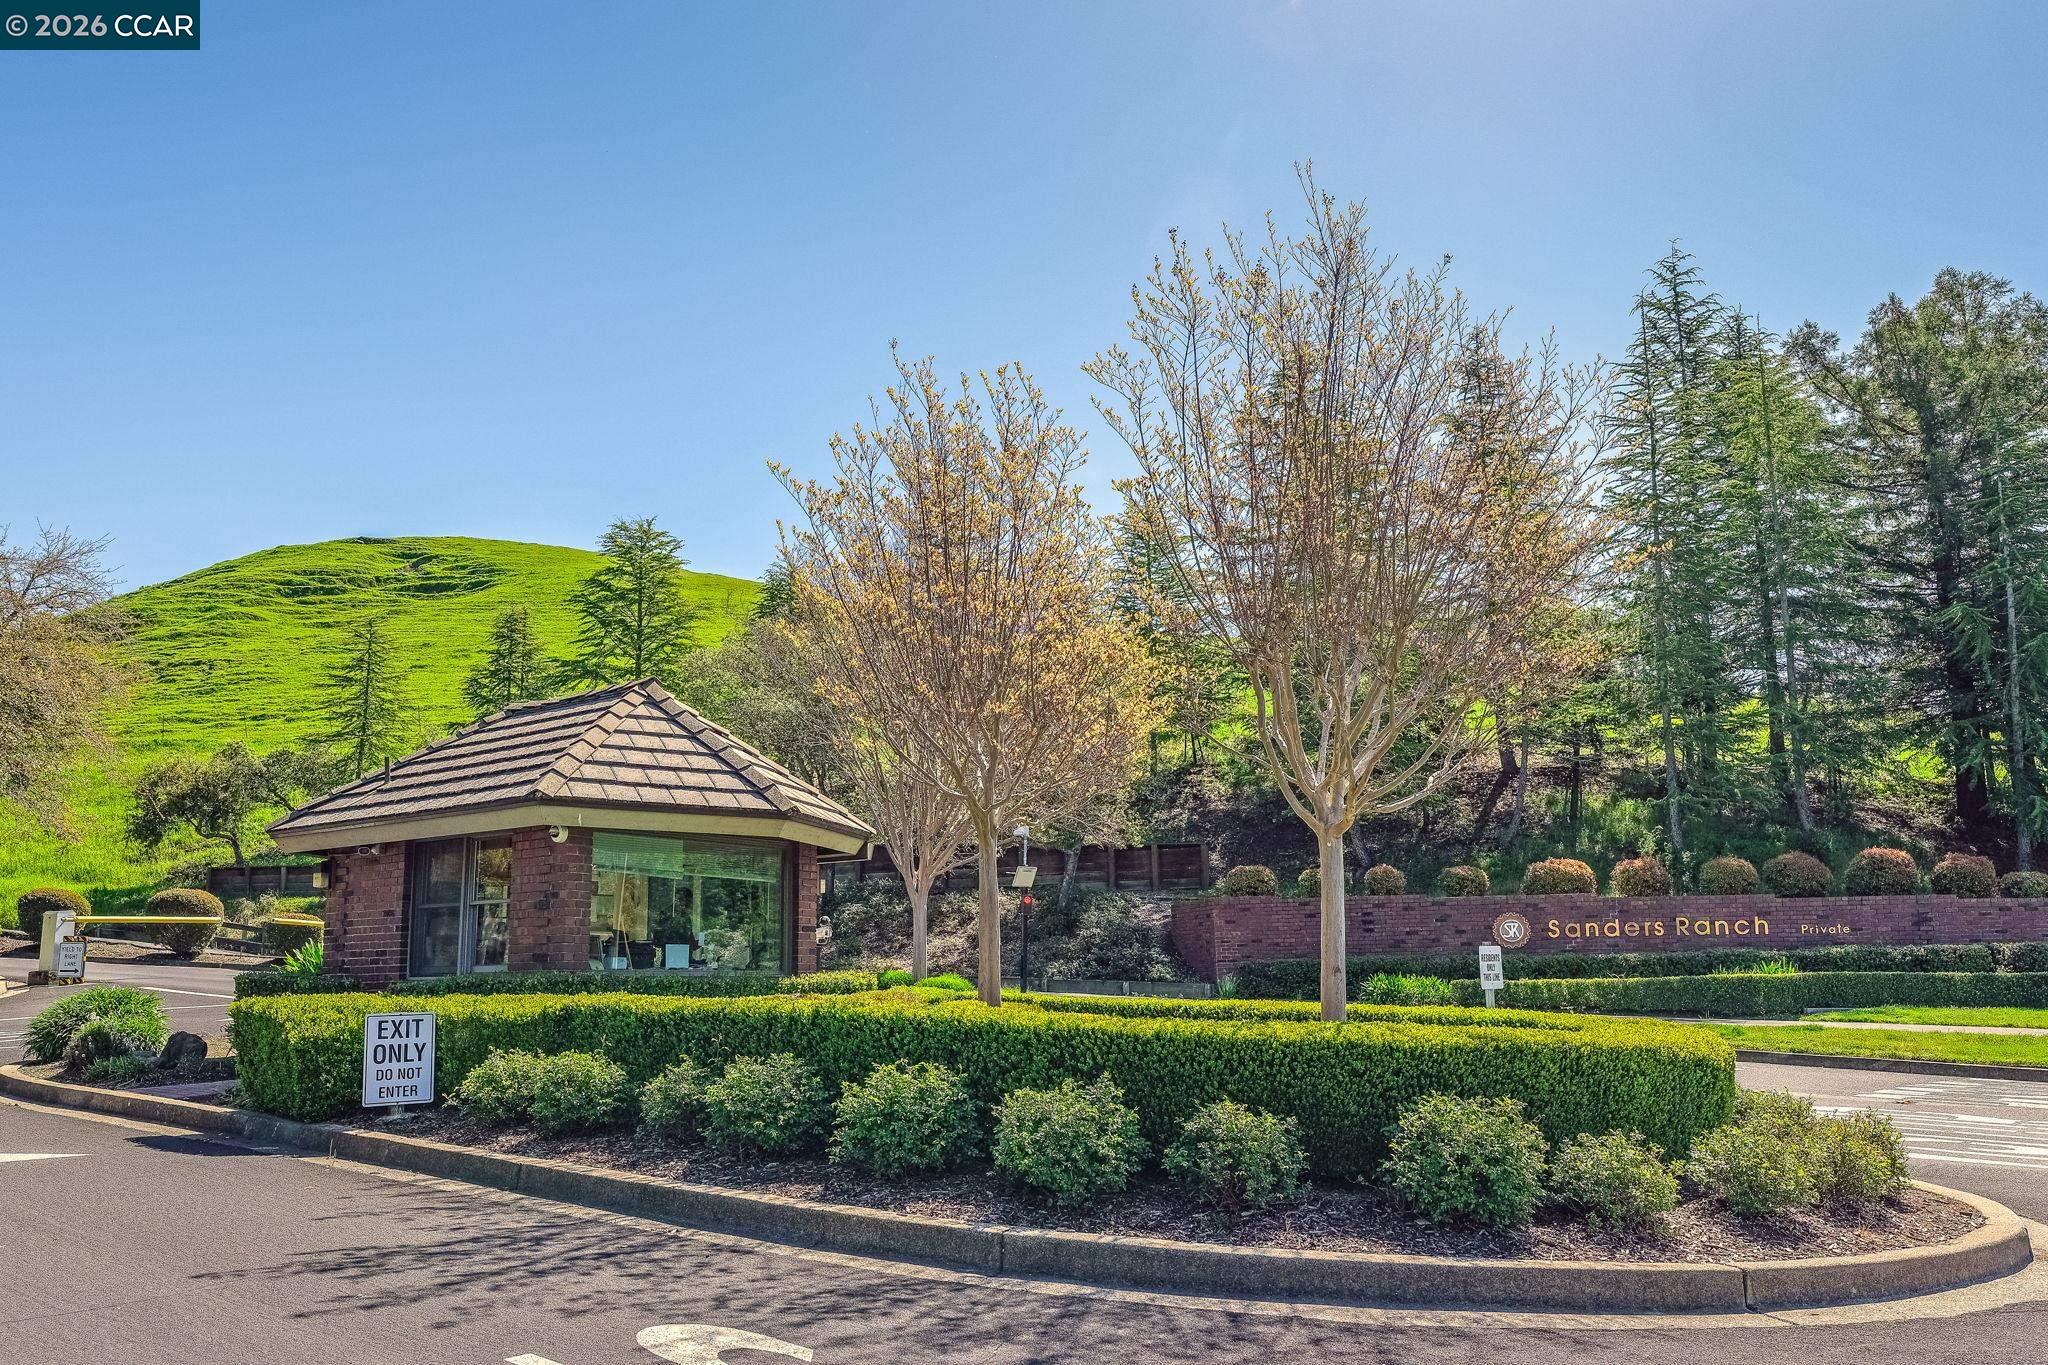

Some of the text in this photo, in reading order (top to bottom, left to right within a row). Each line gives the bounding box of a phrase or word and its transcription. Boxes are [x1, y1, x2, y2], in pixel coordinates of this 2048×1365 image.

[1547, 915, 1769, 938] Sanders Ranch
[1801, 923, 1850, 935] Private
[378, 1019, 424, 1039] EXIT
[373, 1043, 426, 1064] ONLY
[376, 1067, 422, 1081] DO NOT
[379, 1085, 418, 1098] ENTER
